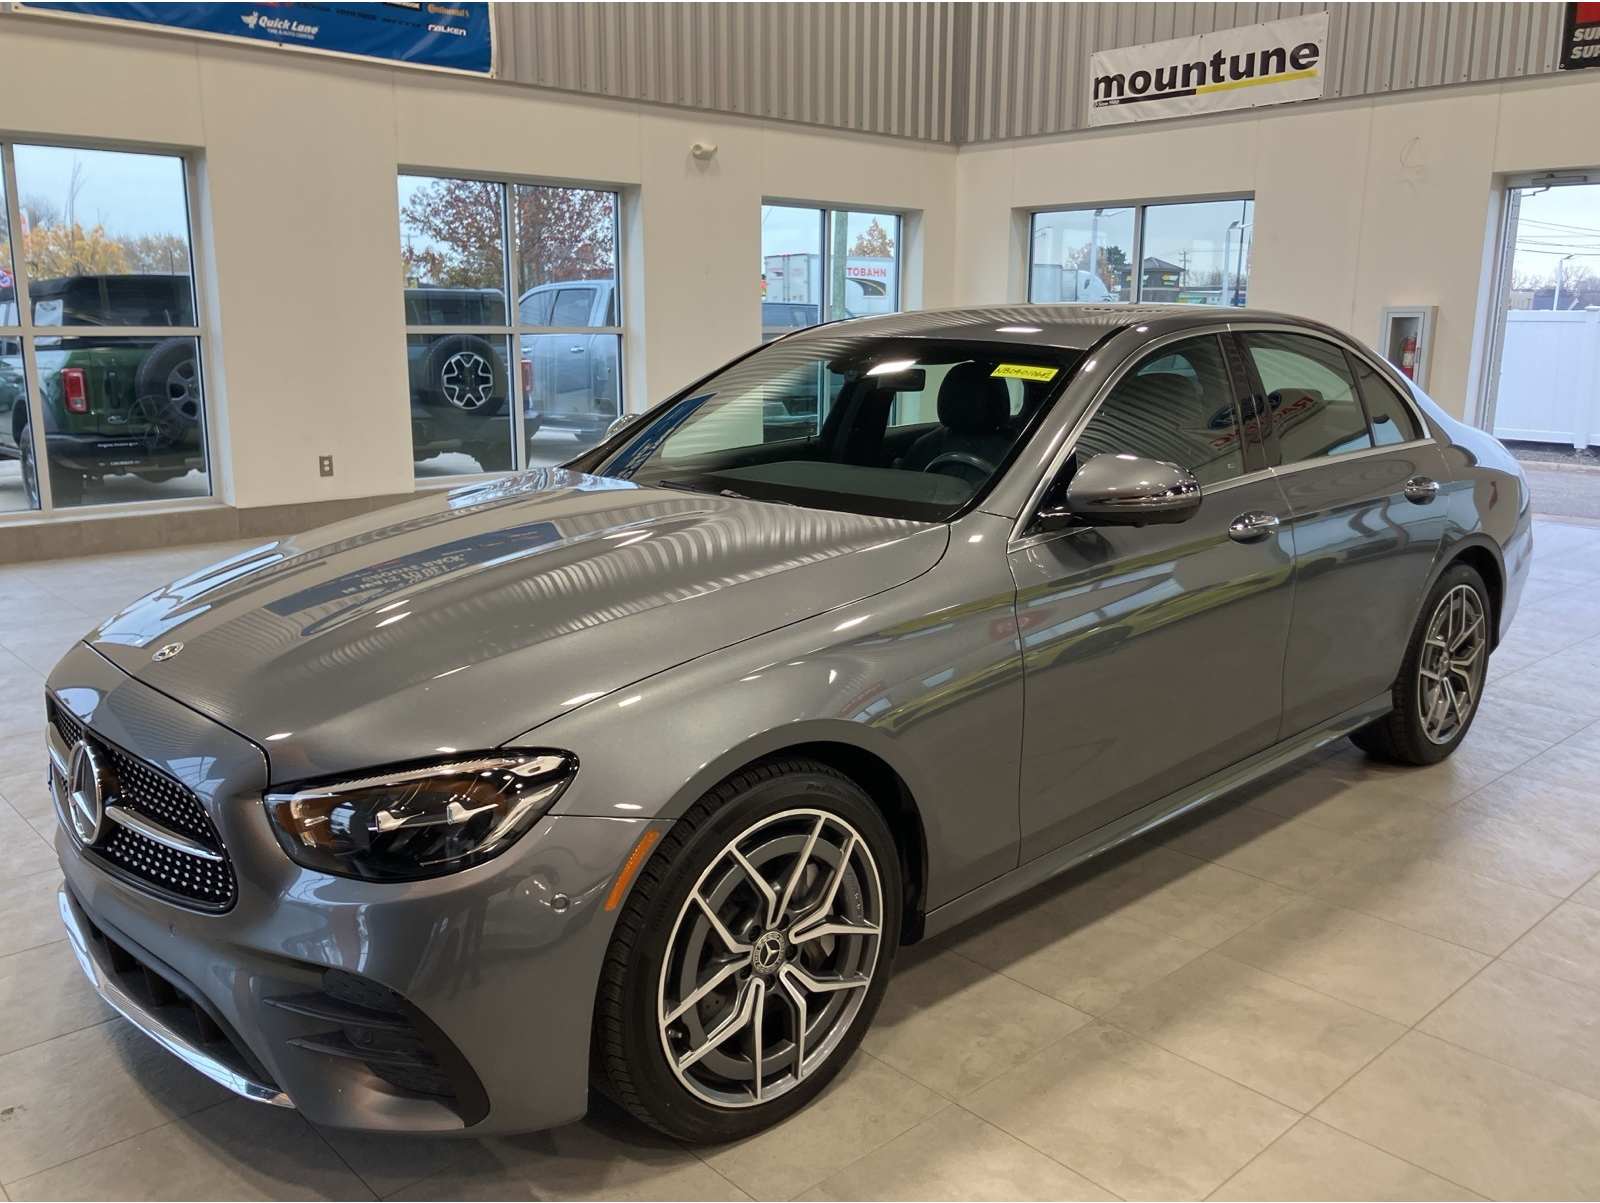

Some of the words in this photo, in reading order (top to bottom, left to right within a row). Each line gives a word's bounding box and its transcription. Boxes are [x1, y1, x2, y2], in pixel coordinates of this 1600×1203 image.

[258, 15, 291, 29] Quick
[291, 20, 319, 35] Lane
[1093, 41, 1320, 100] mountune
